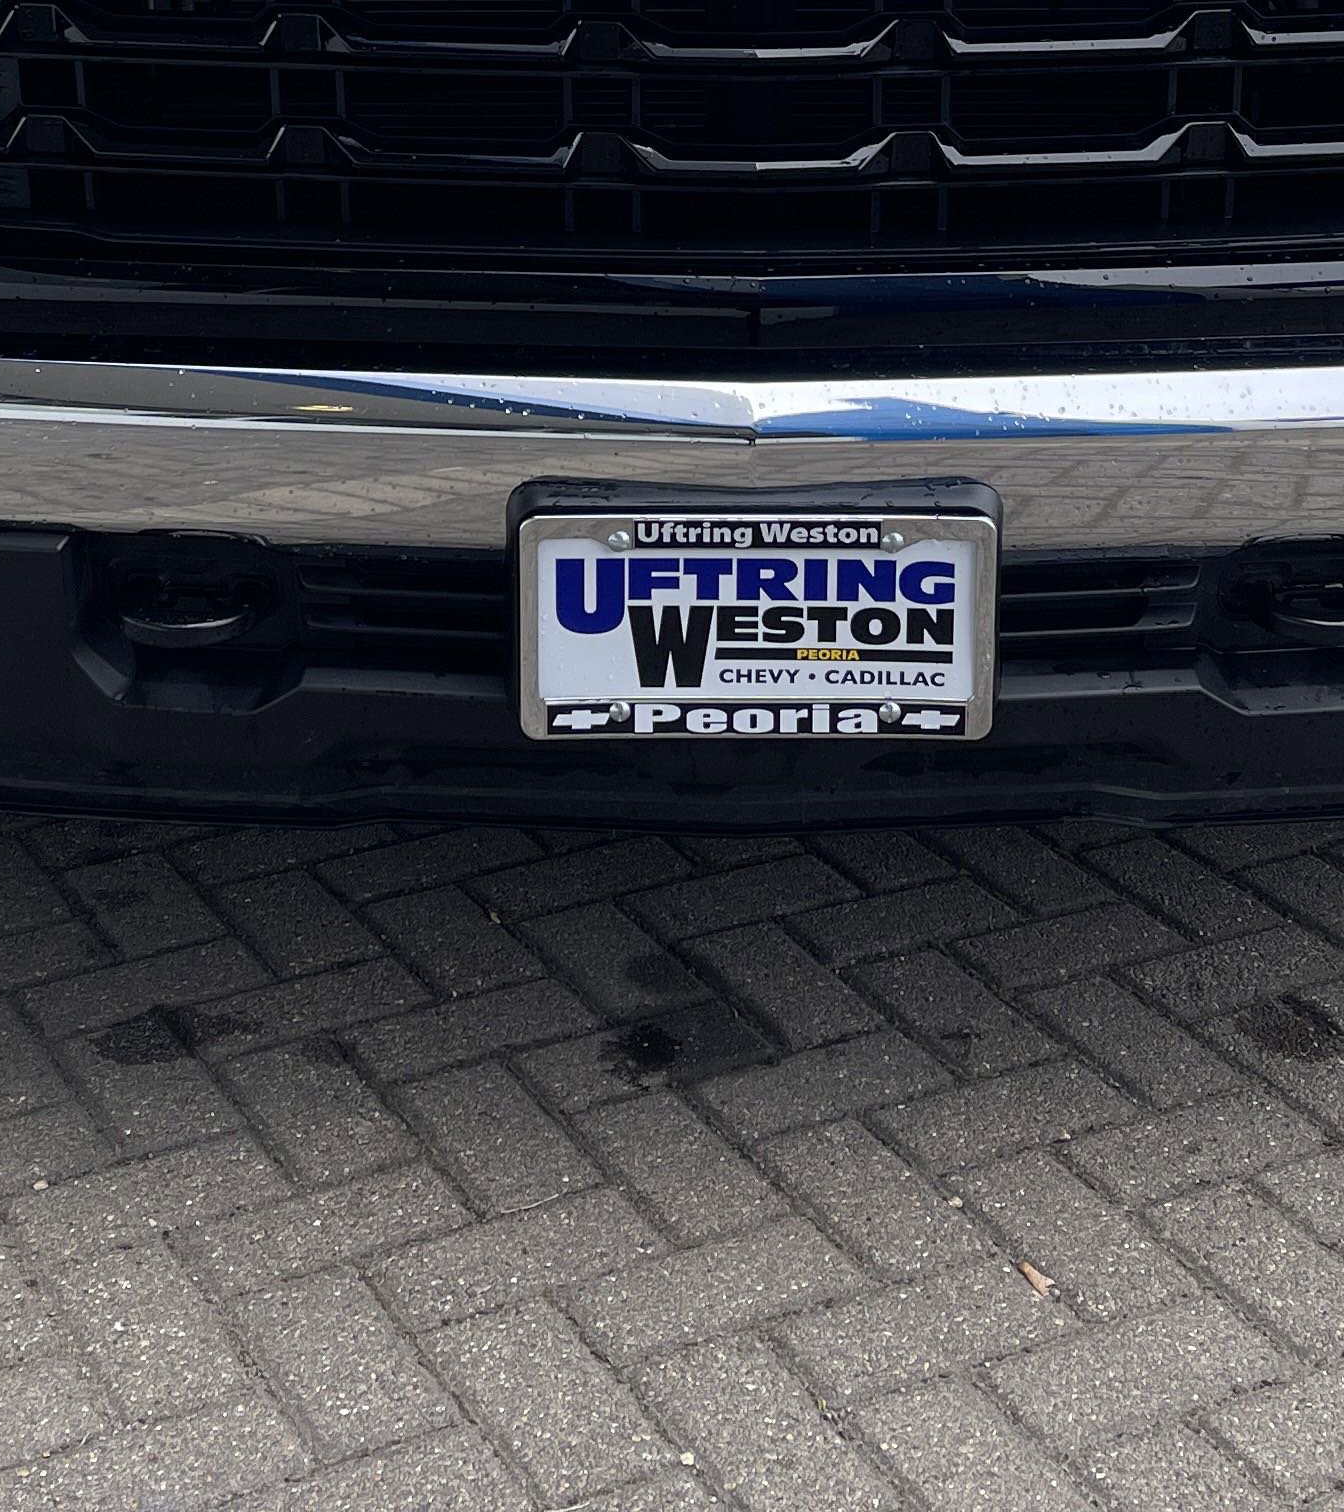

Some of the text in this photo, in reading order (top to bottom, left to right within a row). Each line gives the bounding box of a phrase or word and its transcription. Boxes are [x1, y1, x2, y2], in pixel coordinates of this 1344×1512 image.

[637, 522, 879, 548] Uftring Weston
[556, 558, 955, 635] UFTRING
[628, 605, 954, 688] WESTON
[796, 648, 860, 661] PEORIA
[719, 669, 945, 686] CHEVY CADILLAC
[634, 704, 879, 734] Peoria
